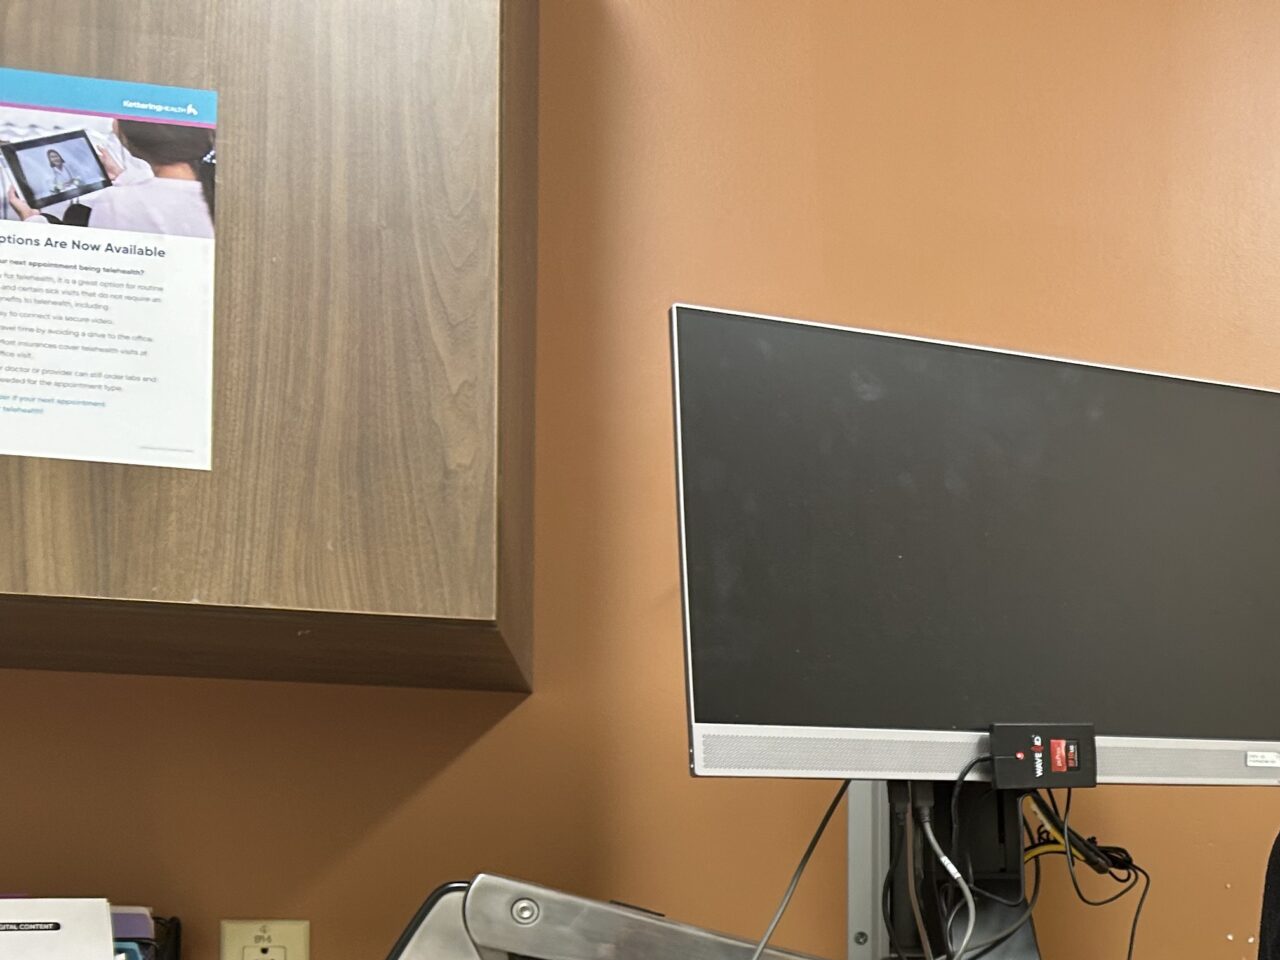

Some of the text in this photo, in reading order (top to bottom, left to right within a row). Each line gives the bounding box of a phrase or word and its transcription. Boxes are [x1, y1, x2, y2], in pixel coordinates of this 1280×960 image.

[44, 237, 68, 249] Are
[71, 239, 101, 252] Now
[104, 243, 166, 258] Available
[28, 260, 77, 269] appointment
[79, 264, 101, 273] being
[102, 267, 145, 275] telehealth?
[1033, 735, 1044, 778] WAVE ID
[19, 923, 54, 931] CONTENT
